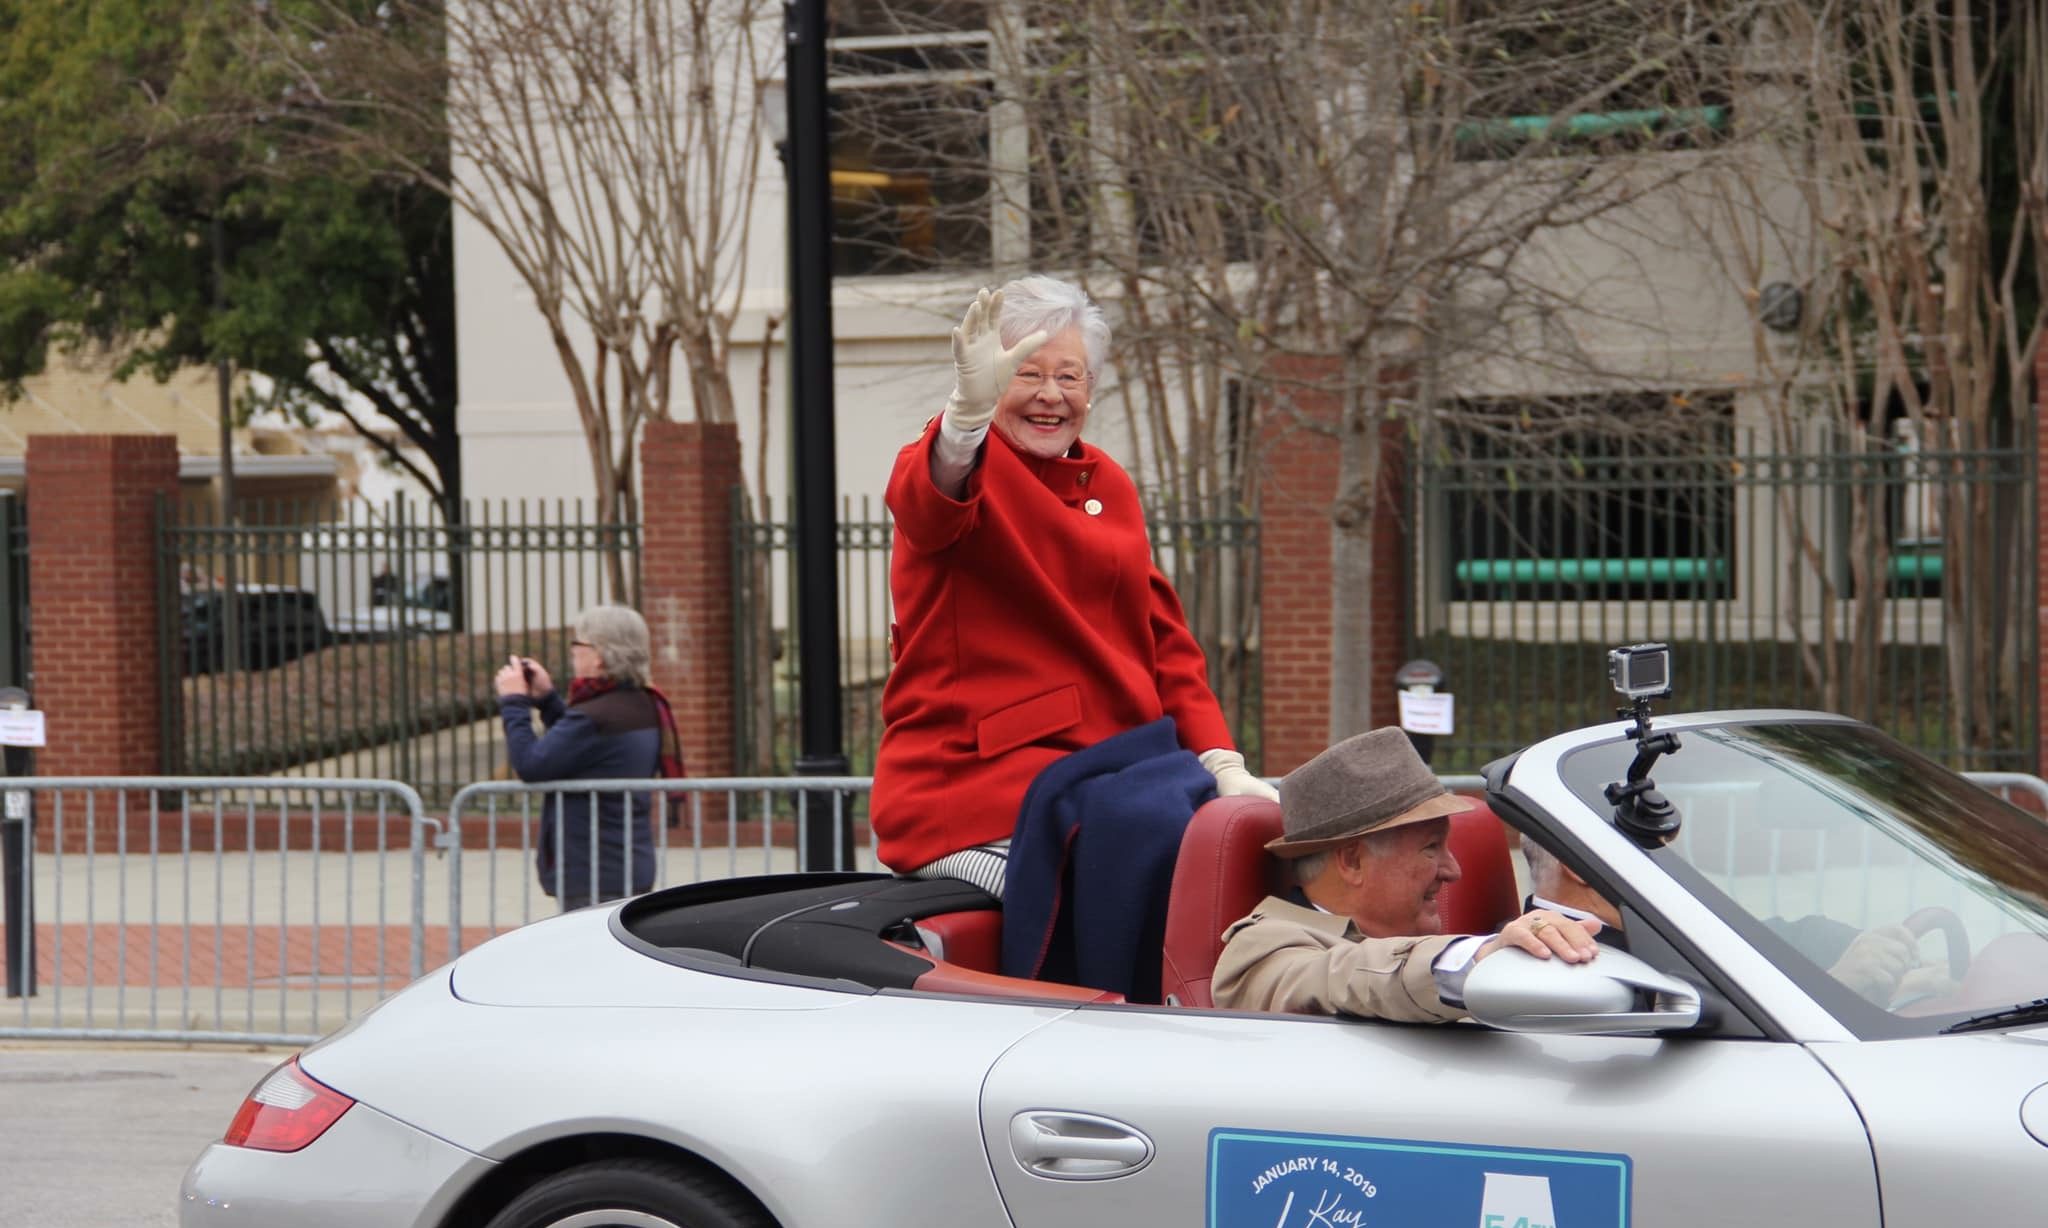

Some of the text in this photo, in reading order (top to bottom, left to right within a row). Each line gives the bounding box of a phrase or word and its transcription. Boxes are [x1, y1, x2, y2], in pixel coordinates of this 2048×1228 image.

[1252, 1157, 1377, 1198] JANUARY 14, 2019
[1305, 1189, 1367, 1228] Kay
